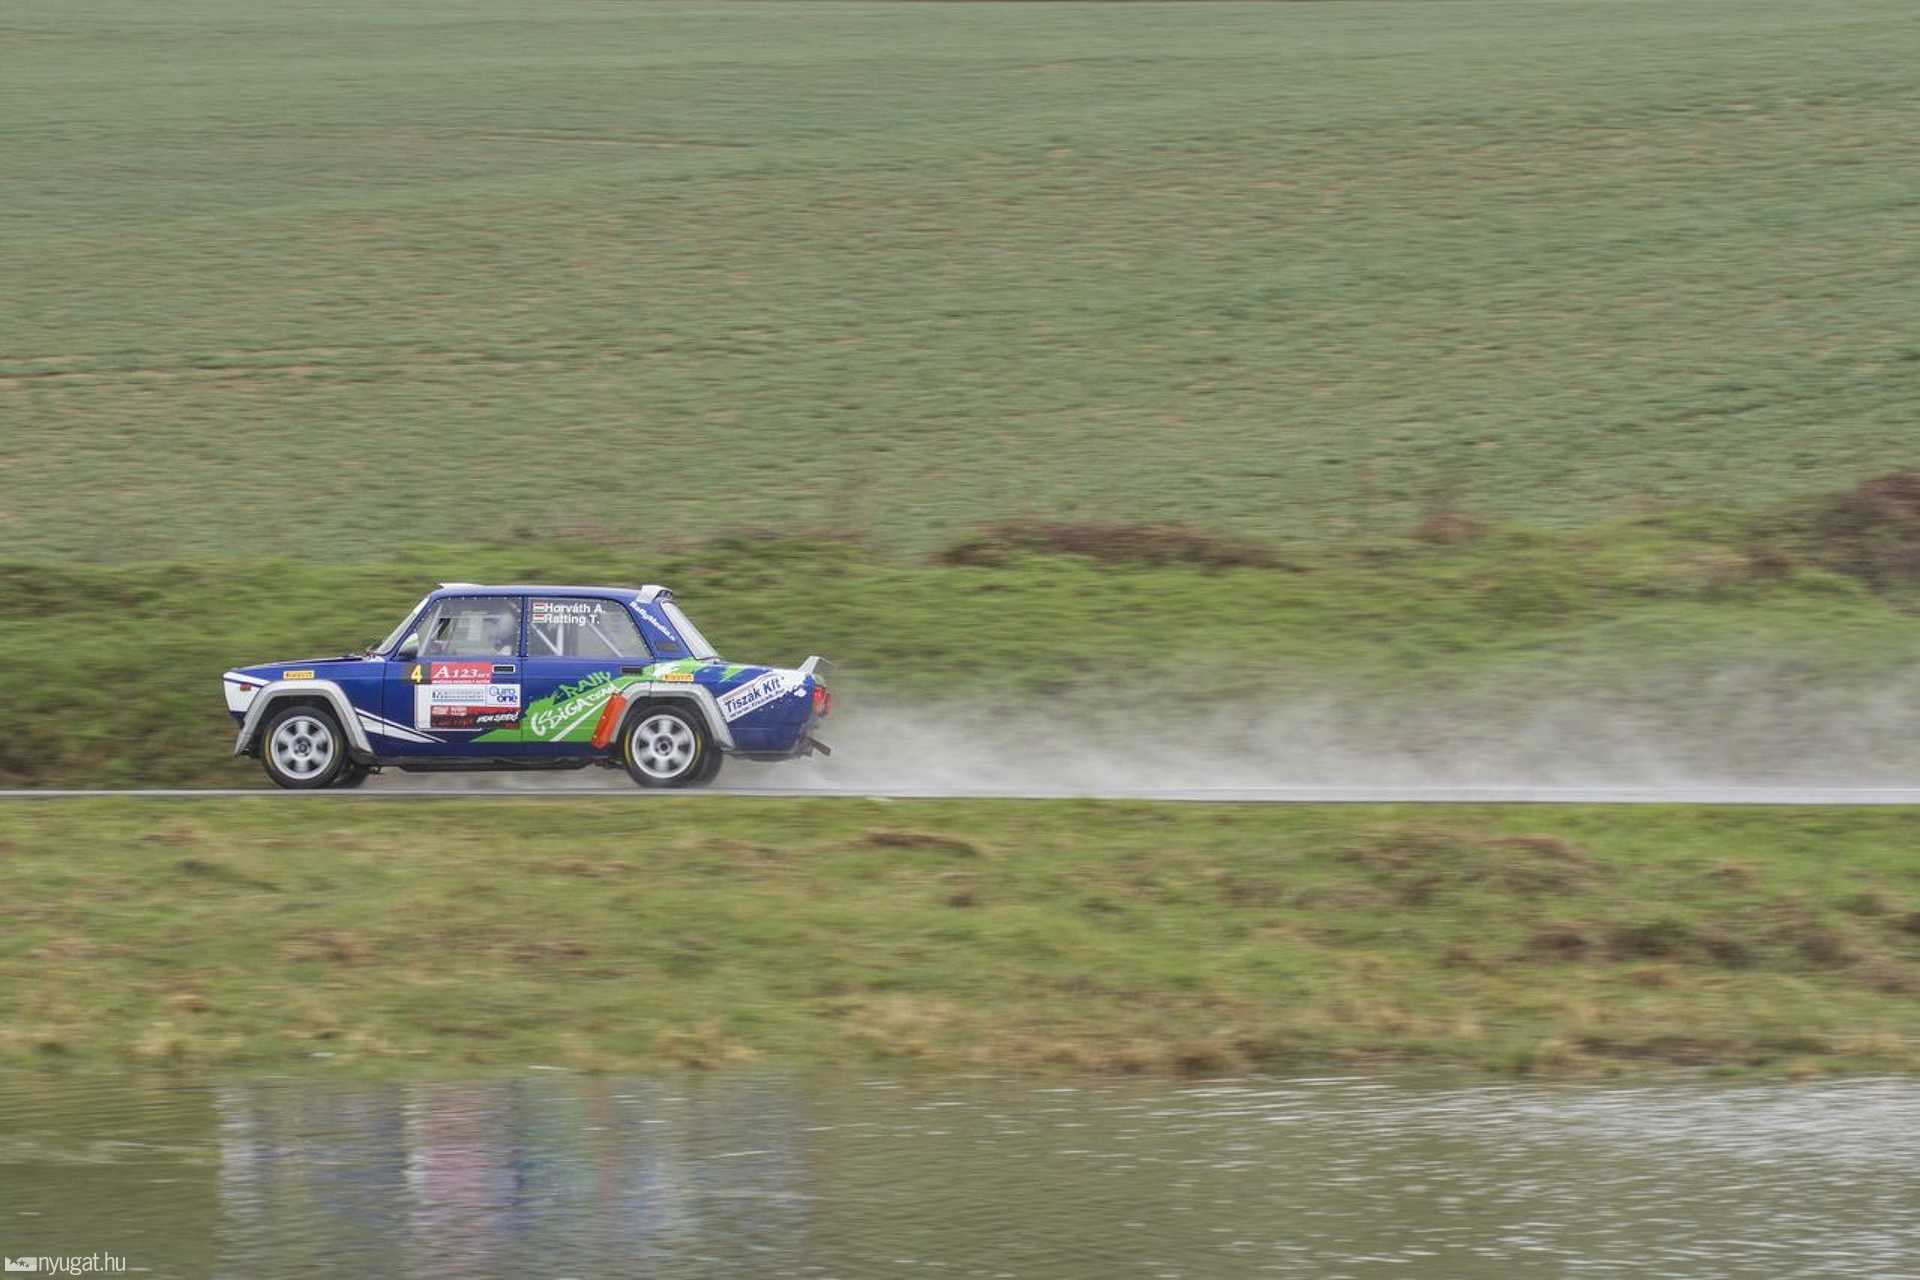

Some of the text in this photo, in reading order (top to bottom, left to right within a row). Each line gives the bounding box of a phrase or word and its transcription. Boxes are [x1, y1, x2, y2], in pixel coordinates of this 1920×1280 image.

[544, 602, 606, 614] Horváth A.
[590, 614, 600, 625] T.
[411, 665, 423, 682] 4
